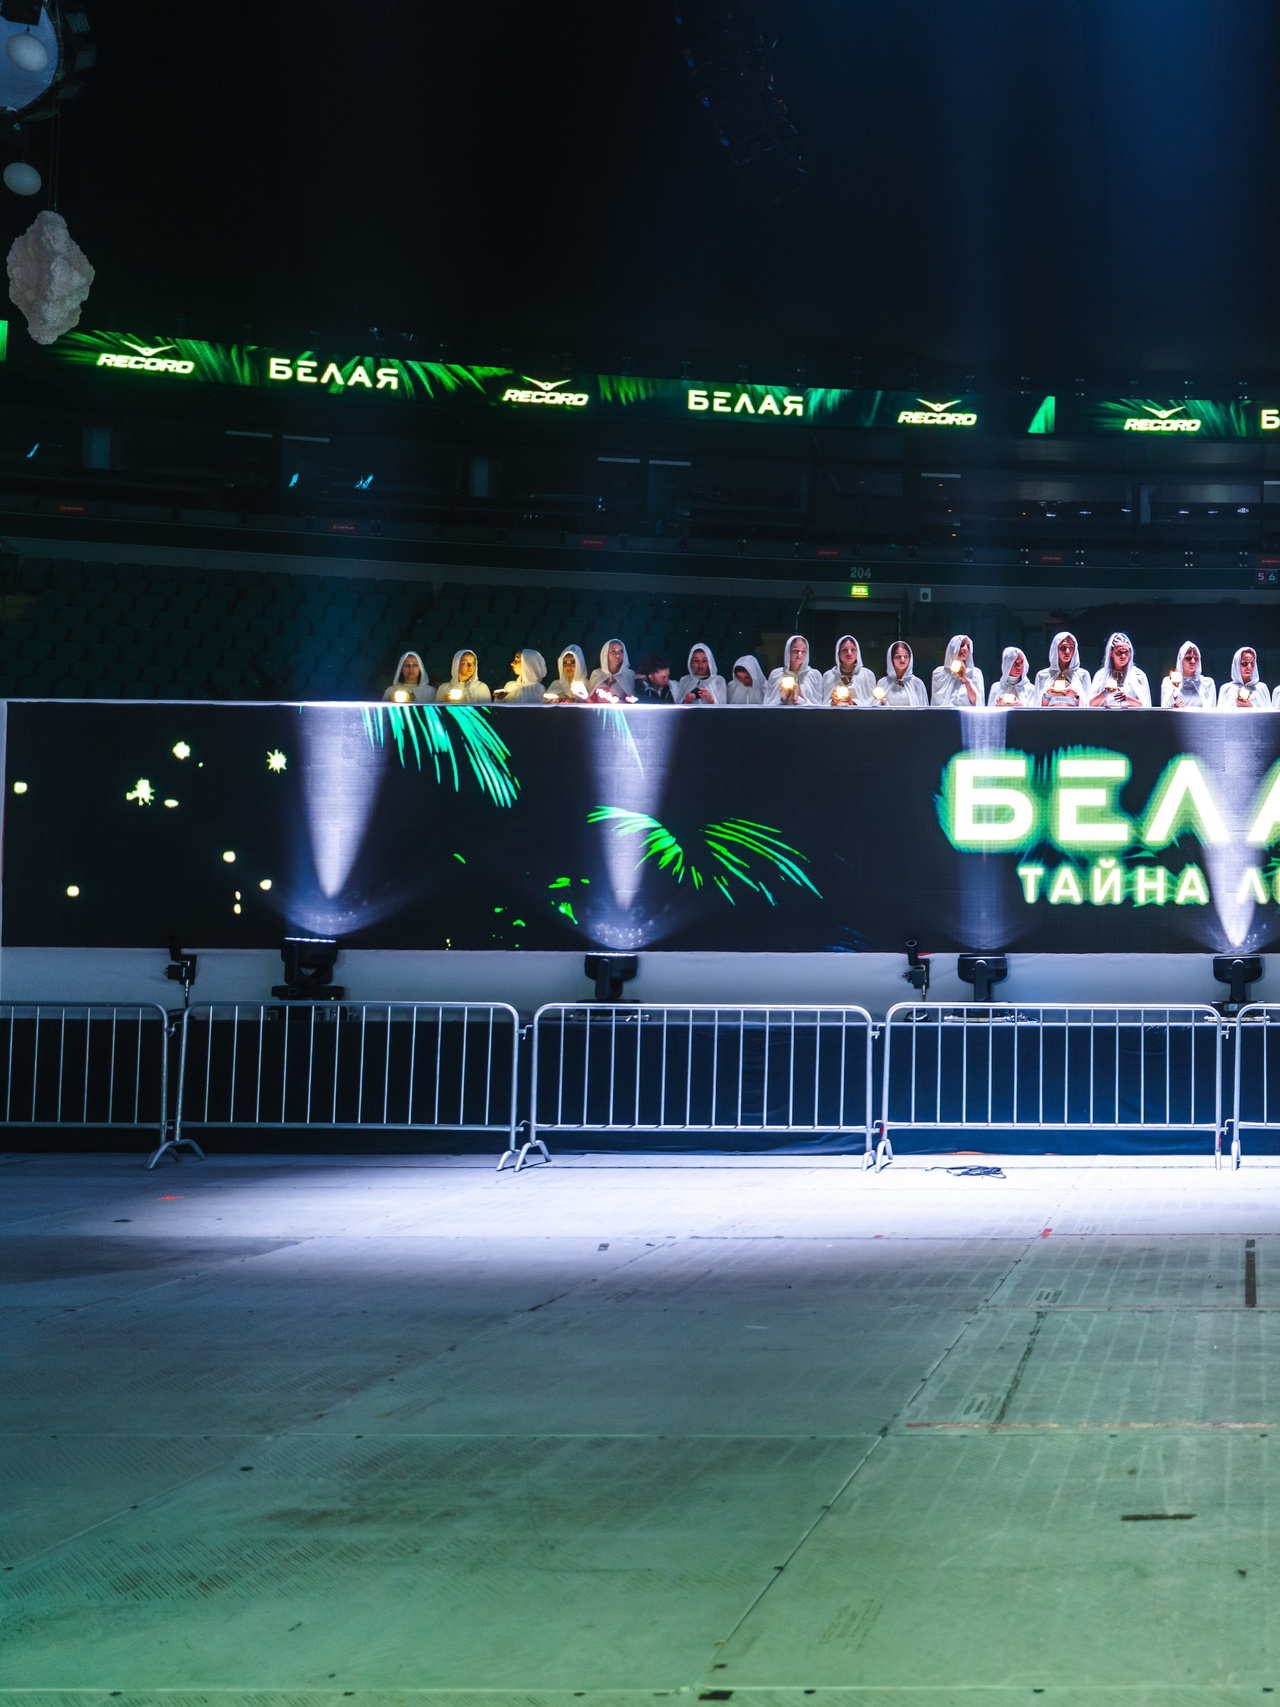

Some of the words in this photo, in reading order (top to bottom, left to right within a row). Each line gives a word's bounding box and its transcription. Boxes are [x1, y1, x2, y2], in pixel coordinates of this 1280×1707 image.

[97, 353, 195, 374] RECORD
[269, 357, 398, 390] БЕЛАЯ
[502, 388, 589, 406] RECORD
[687, 389, 803, 417] БЕЛАЯ
[897, 411, 978, 426] RECORD
[1123, 418, 1202, 432] RECORD
[849, 566, 872, 579] 204
[1257, 572, 1265, 581] 5
[1268, 572, 1276, 581] 6
[1016, 858, 1209, 904] ТАЙНА
